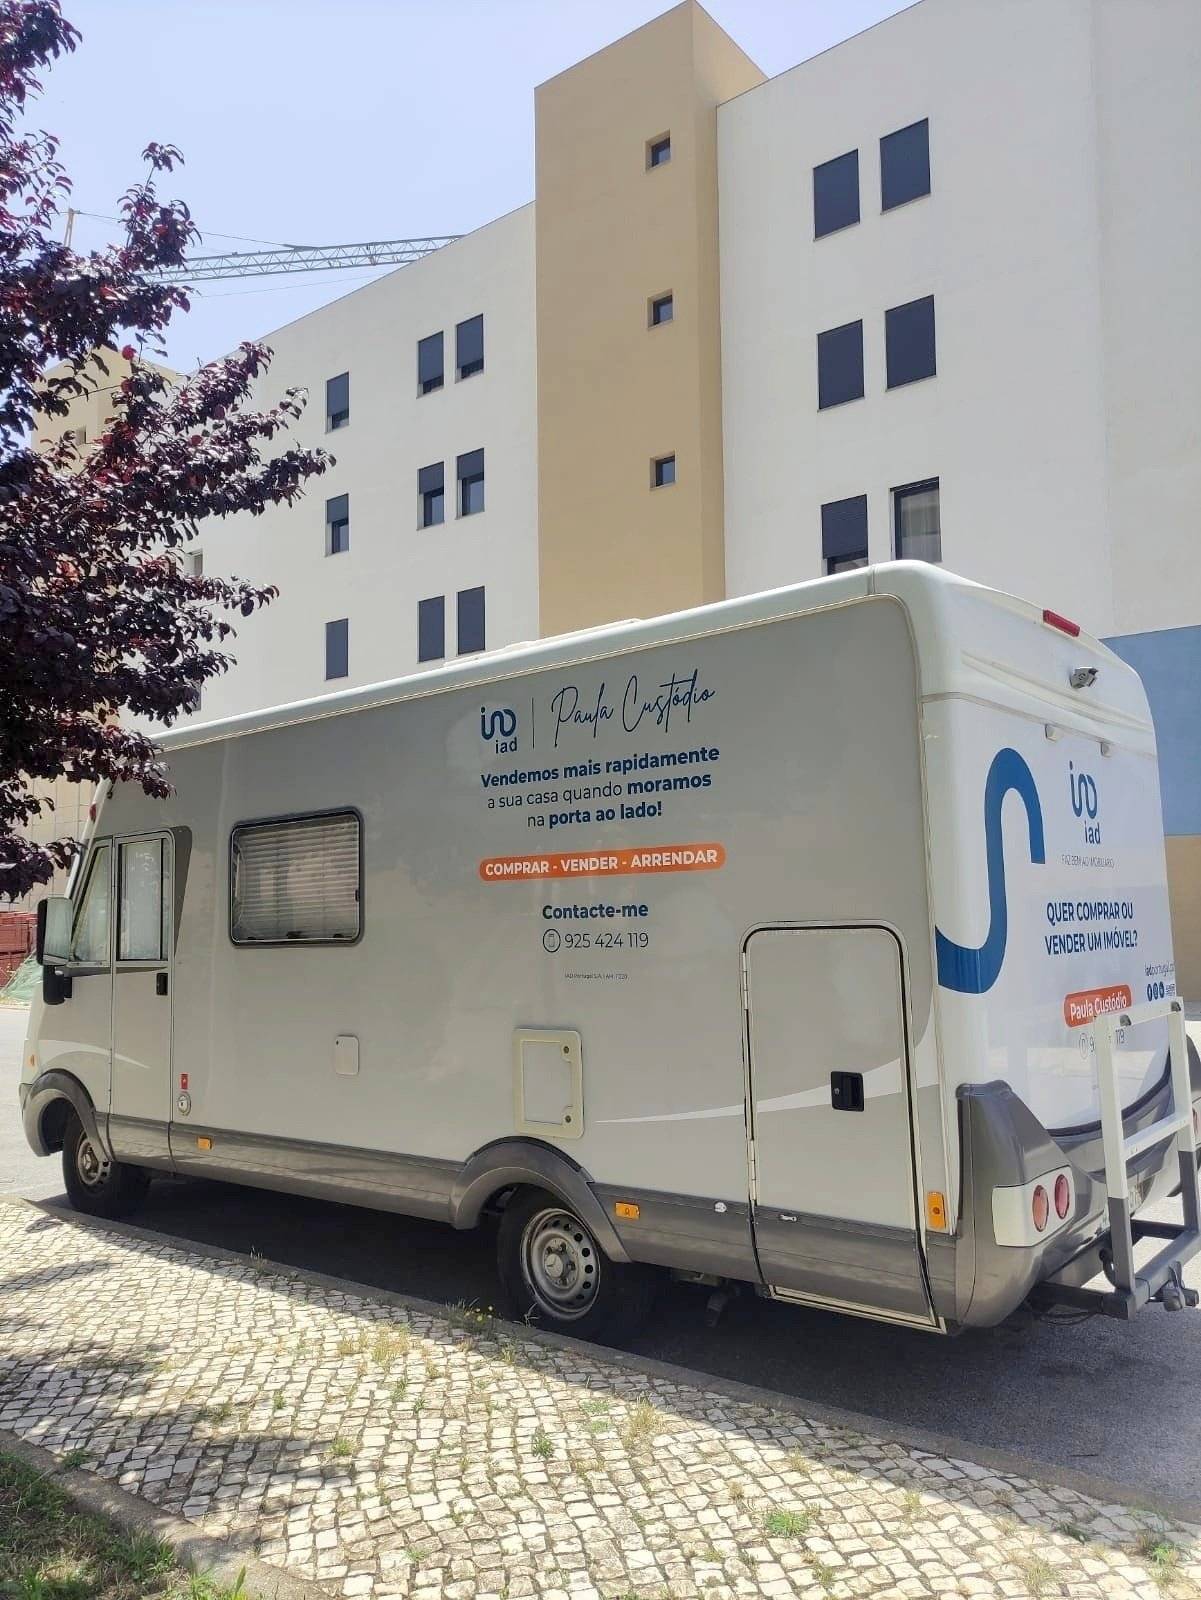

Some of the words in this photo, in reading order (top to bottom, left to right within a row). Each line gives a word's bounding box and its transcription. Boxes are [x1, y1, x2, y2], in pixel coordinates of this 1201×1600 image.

[551, 683, 614, 748] Paula
[622, 669, 716, 733] Custódio
[495, 738, 518, 754] iad
[481, 769, 559, 788] Vendemos
[563, 760, 601, 778] mais
[605, 745, 720, 775] rapidamente
[487, 799, 495, 809] a
[498, 794, 523, 808] sua
[526, 791, 558, 805] casa
[562, 781, 623, 802] quando
[627, 772, 712, 795] moramos
[527, 814, 545, 828] na
[549, 808, 591, 829] porta
[595, 806, 616, 821] ao
[620, 801, 663, 820] lado!
[1084, 820, 1101, 845] iad
[485, 860, 549, 876] COMPRAR
[560, 856, 618, 873] VENDER
[630, 849, 718, 868] ARRENDAR
[542, 903, 649, 920] Contacte-me
[1046, 902, 1075, 926] QUER
[1076, 902, 1120, 922] COMPRAR
[1121, 902, 1134, 919] OU
[564, 933, 591, 949] 925
[594, 932, 624, 948] 424
[628, 932, 649, 948] 119
[1045, 934, 1085, 955] VENDER
[1087, 930, 1101, 951] UM
[1103, 927, 1138, 949] IMÓVEL?
[1070, 1000, 1094, 1021] Paula
[1094, 991, 1127, 1015] Custódio
